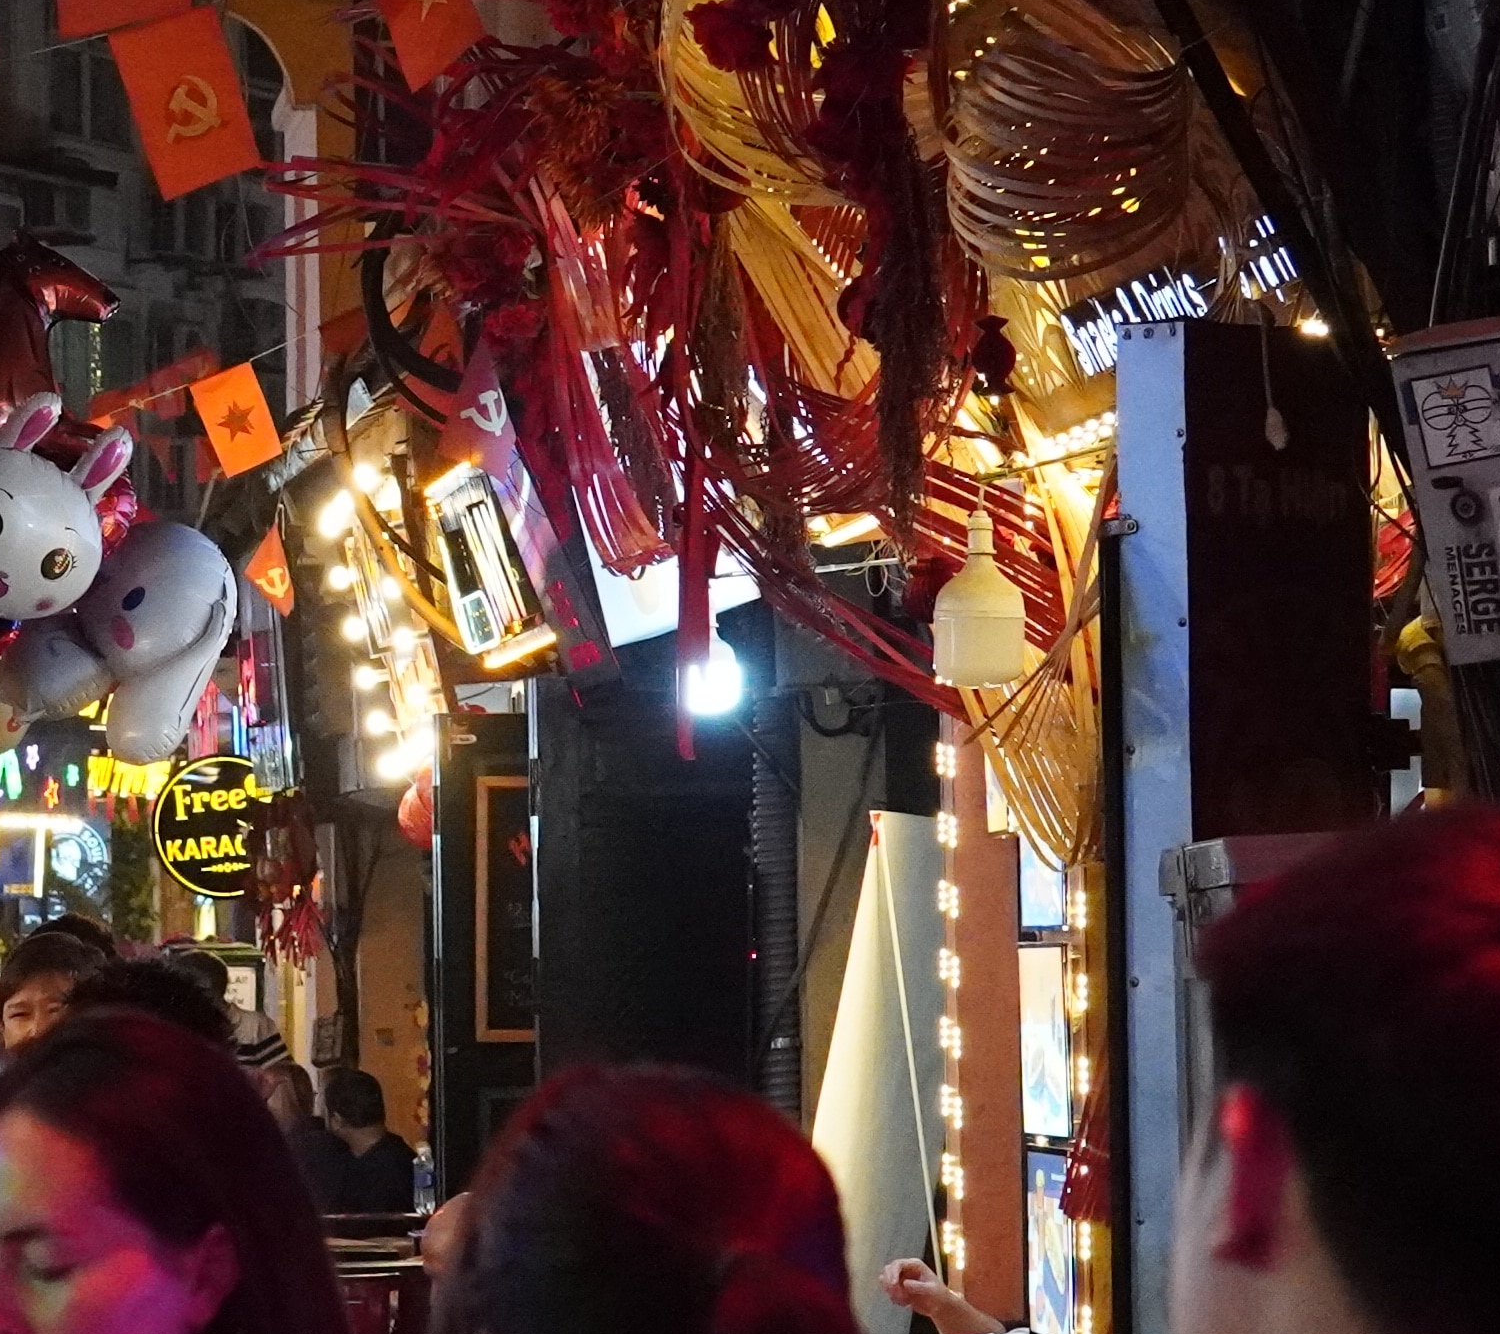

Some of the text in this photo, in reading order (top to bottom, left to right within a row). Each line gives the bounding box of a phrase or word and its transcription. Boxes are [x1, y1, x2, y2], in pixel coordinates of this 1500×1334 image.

[1130, 265, 1209, 318] Drinks
[1444, 545, 1468, 635] MENACES
[171, 783, 248, 821] Free
